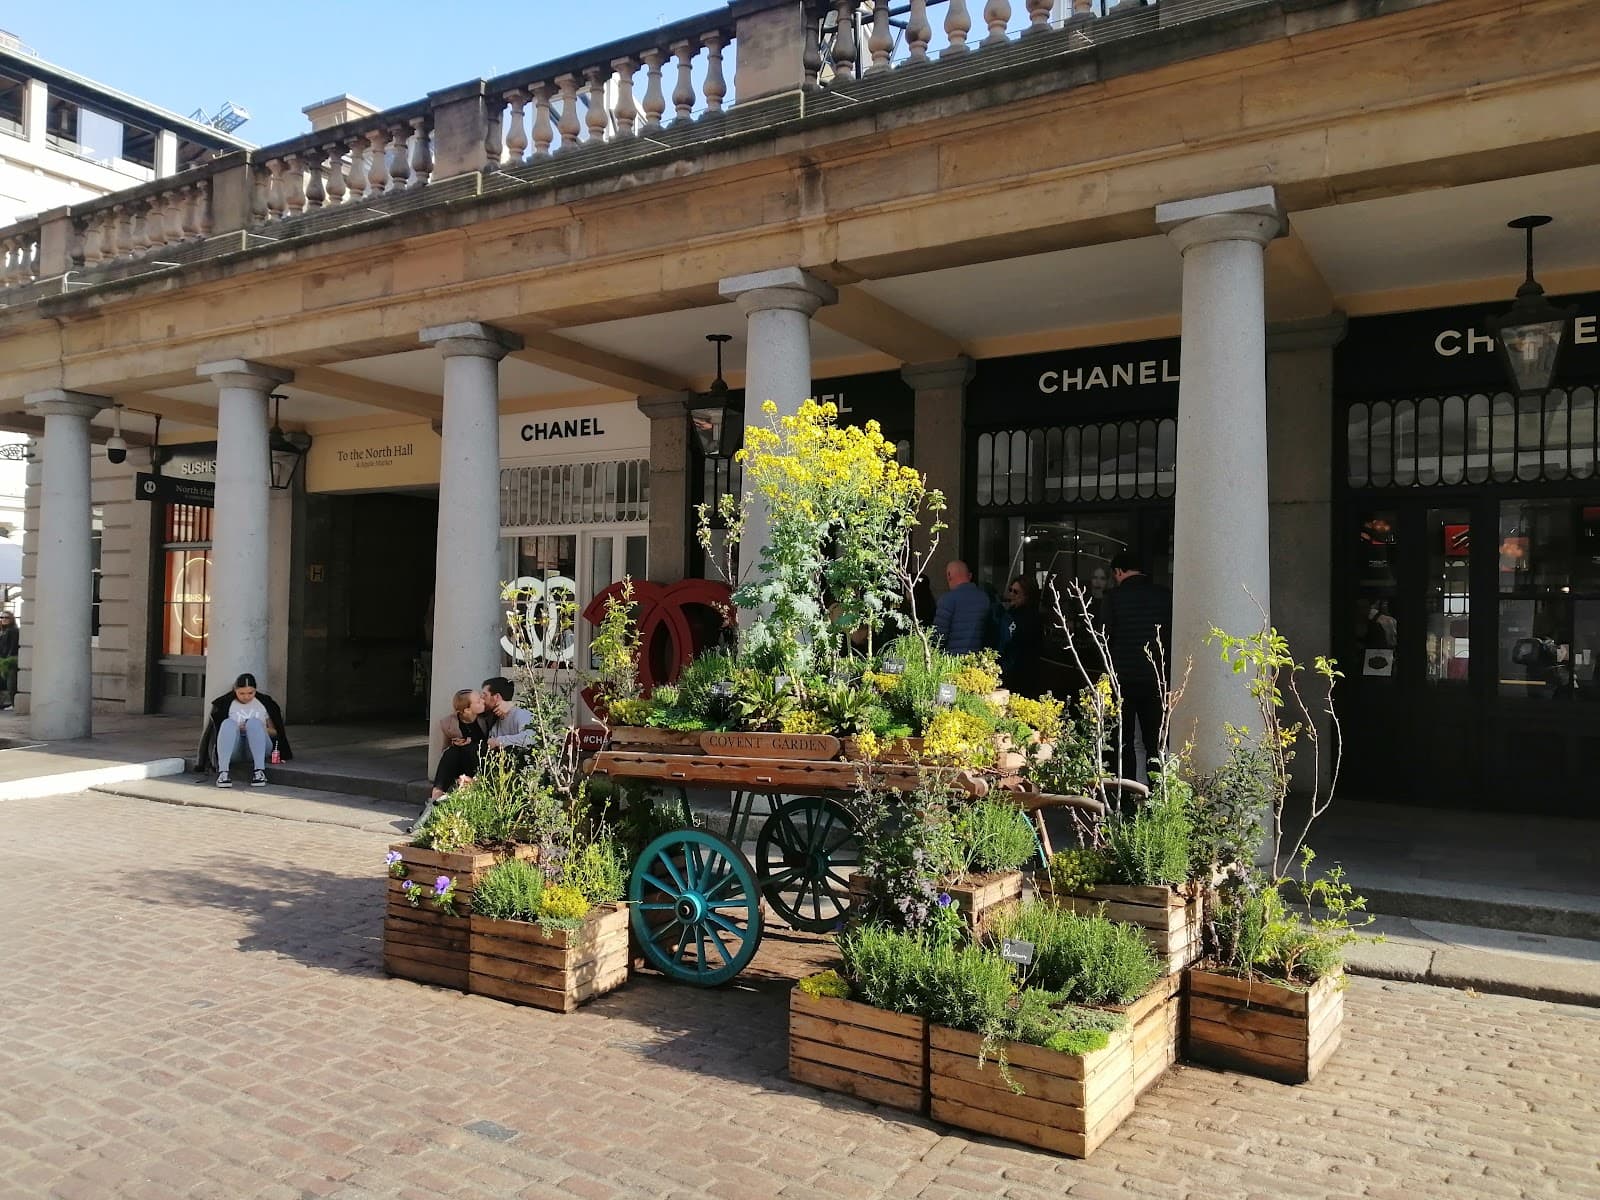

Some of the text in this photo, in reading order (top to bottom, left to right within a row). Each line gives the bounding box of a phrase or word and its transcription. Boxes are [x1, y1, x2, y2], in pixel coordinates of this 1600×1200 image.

[1039, 360, 1180, 394] CHANEL
[521, 418, 605, 441] CHANEL
[337, 443, 413, 461] To the North Hall
[710, 735, 827, 751] COVENT GARDEN
